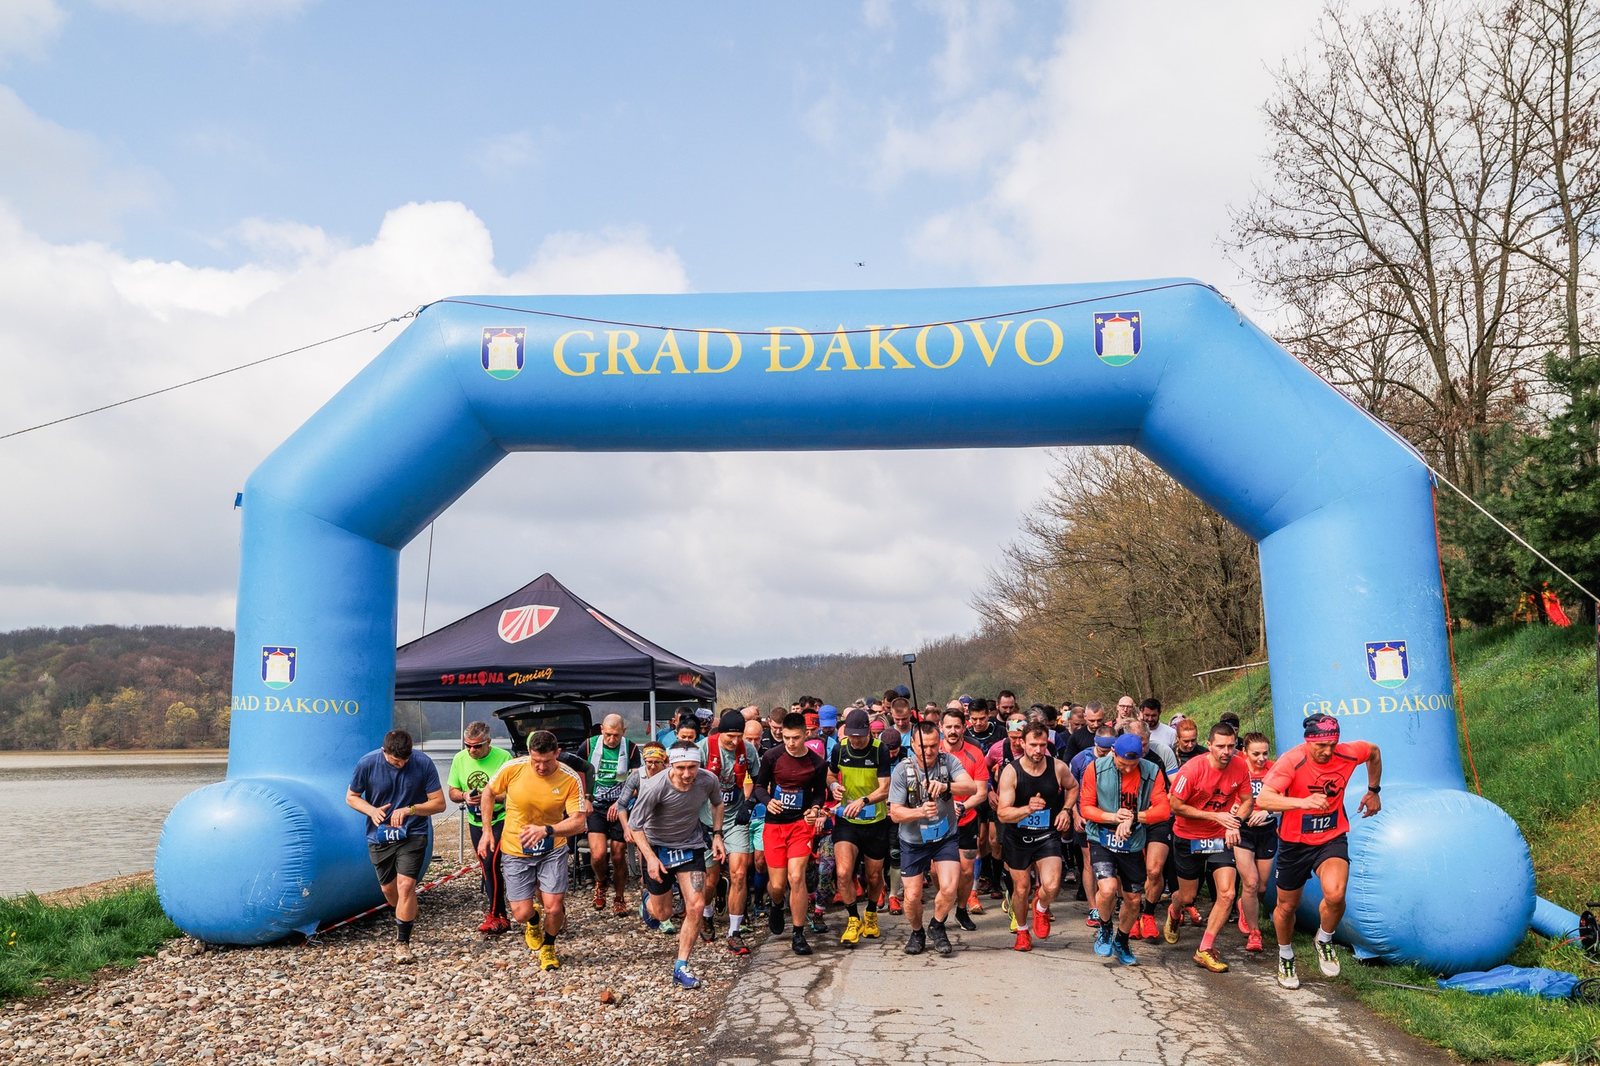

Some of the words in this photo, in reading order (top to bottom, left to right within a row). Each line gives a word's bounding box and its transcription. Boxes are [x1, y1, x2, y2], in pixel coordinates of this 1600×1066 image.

[553, 328, 742, 377] GRAD
[762, 318, 1064, 372] ĐAKOVO
[441, 674, 455, 685] 99
[508, 667, 553, 686] Timing
[264, 696, 359, 716] ĐAKOVO
[1303, 698, 1371, 718] GRAD
[779, 793, 797, 806] 162
[1028, 815, 1041, 826] 33
[1311, 817, 1331, 829] 112
[384, 830, 400, 841] 141
[934, 828, 939, 837] 7
[1200, 838, 1214, 848] 96
[667, 850, 685, 863] 111
